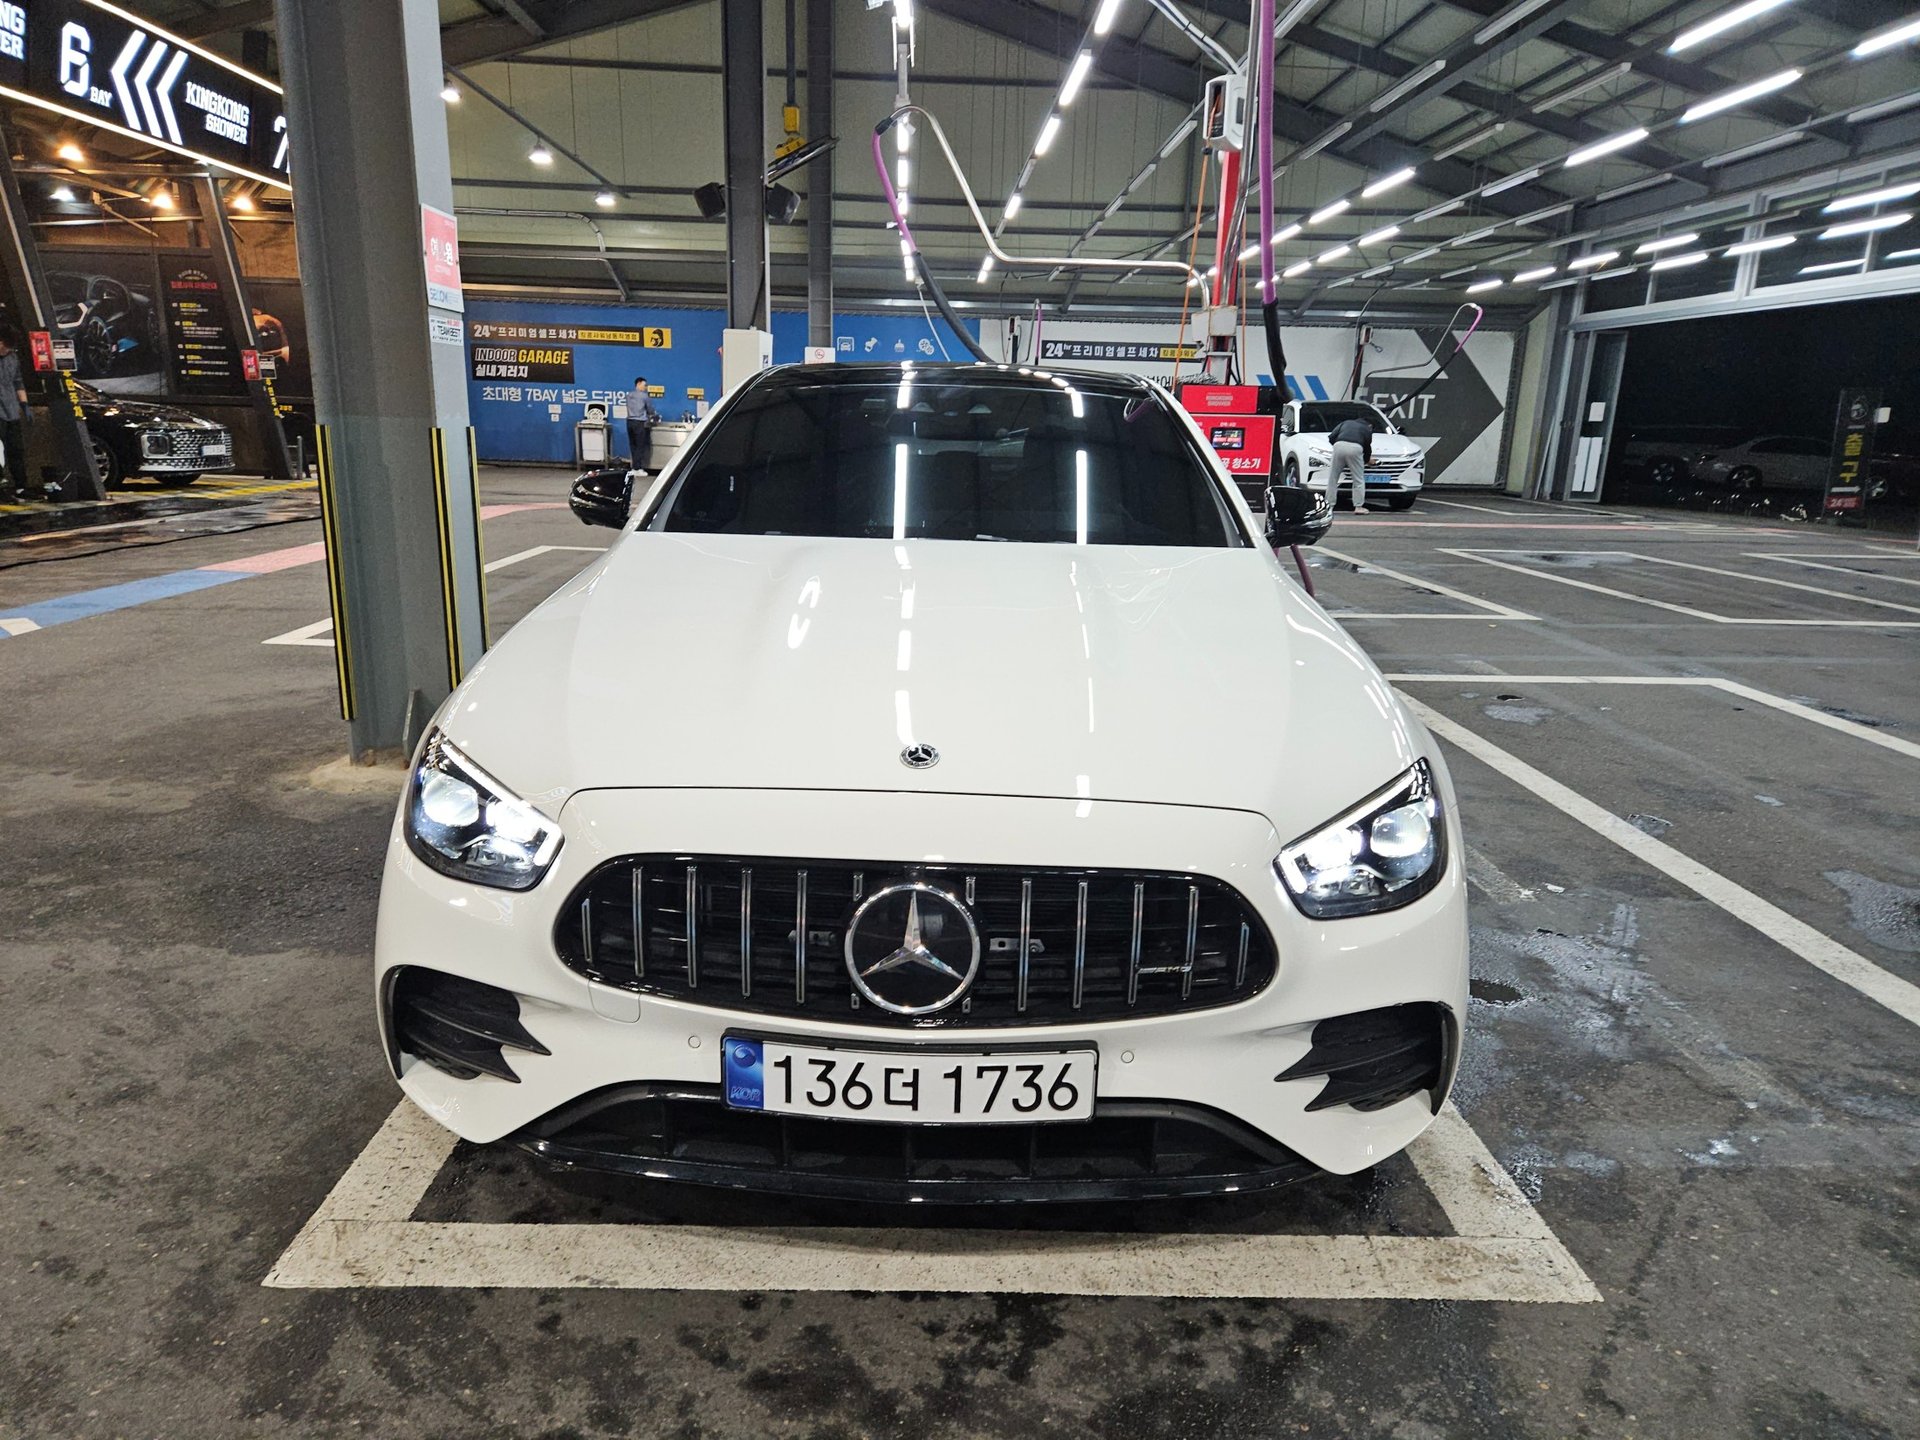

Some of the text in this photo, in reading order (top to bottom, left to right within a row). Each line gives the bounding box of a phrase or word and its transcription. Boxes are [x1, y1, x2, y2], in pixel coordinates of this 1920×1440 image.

[60, 21, 113, 108] 6 BAY
[185, 81, 250, 126] KINGKONG
[205, 113, 248, 145] SHOWER
[475, 347, 570, 365] INDOOR GARAGE
[475, 364, 528, 378] 실내게러지
[482, 386, 522, 402] 초대형
[525, 388, 559, 402] 7BAY
[562, 389, 588, 404] 넓은
[1372, 393, 1436, 419] EXIT
[1232, 457, 1262, 469] 청소기
[773, 1055, 1079, 1114] 136더 1736
